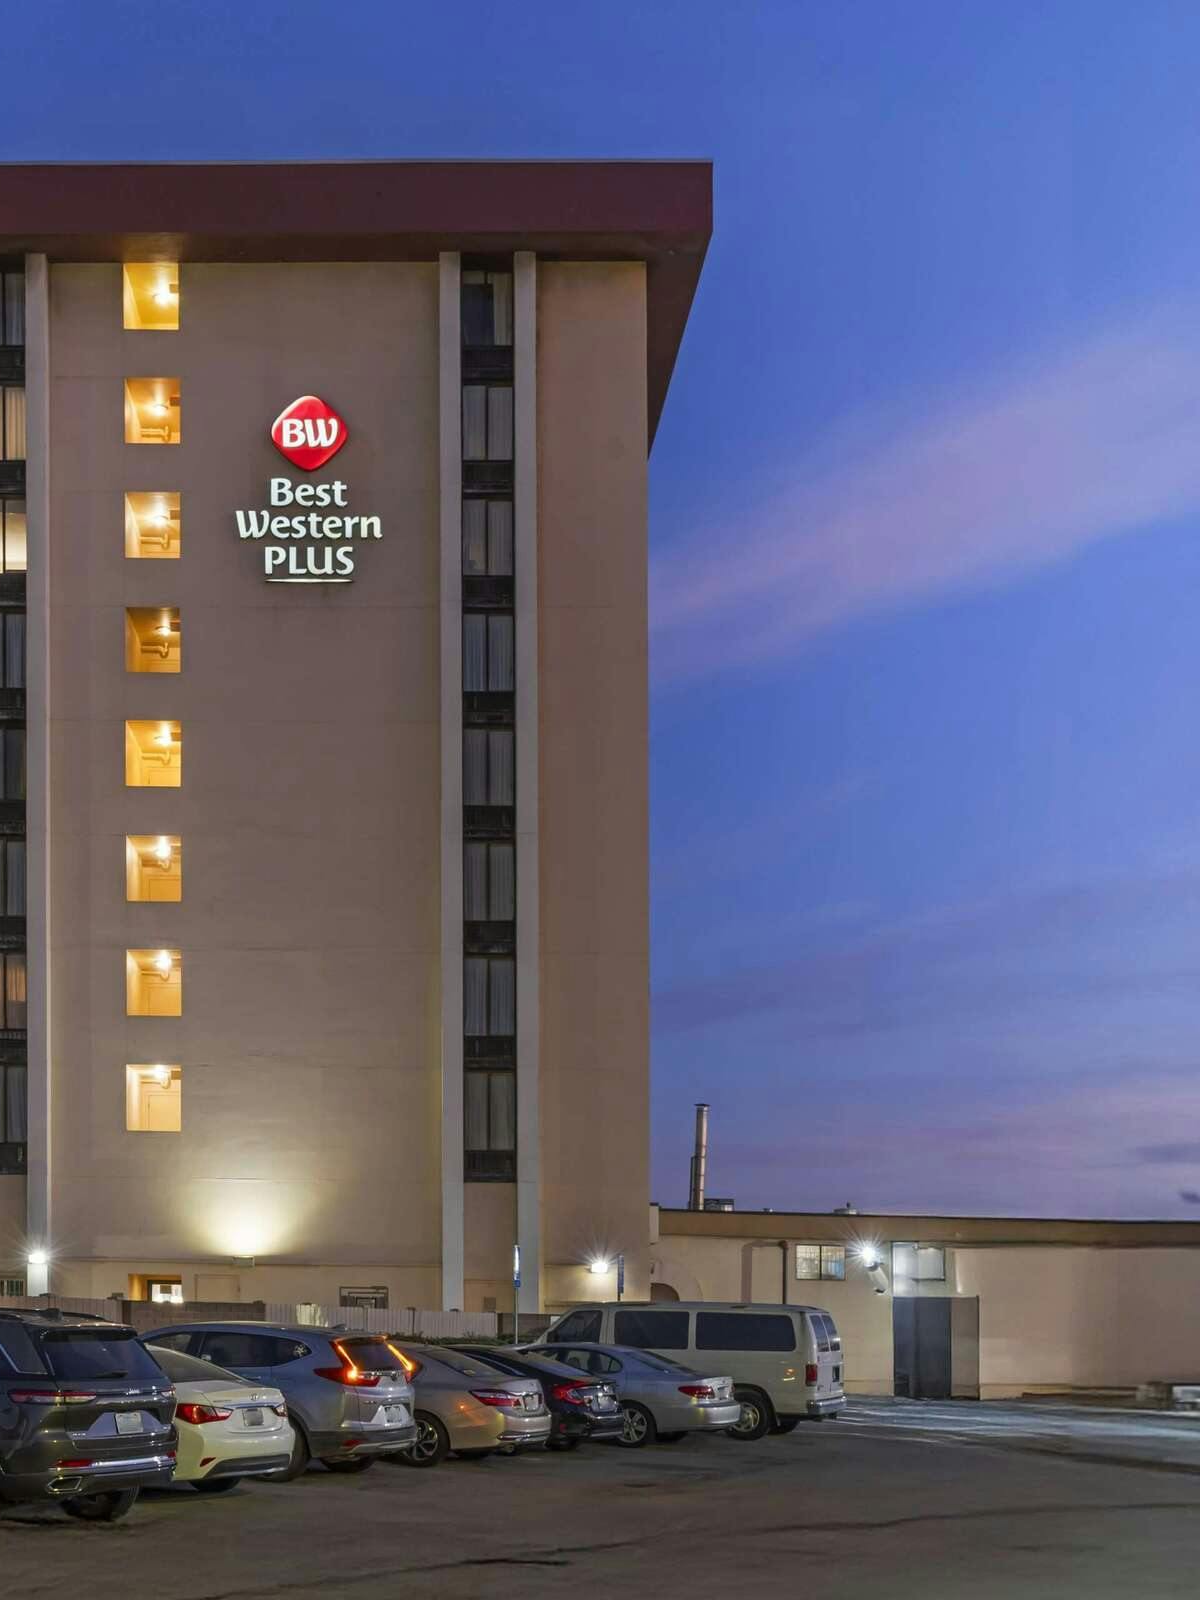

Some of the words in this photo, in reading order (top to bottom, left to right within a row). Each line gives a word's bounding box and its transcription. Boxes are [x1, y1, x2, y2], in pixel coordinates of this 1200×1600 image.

[282, 418, 338, 447] BW
[270, 477, 348, 507] Best
[235, 510, 383, 539] Western
[264, 546, 355, 575] PLUS
